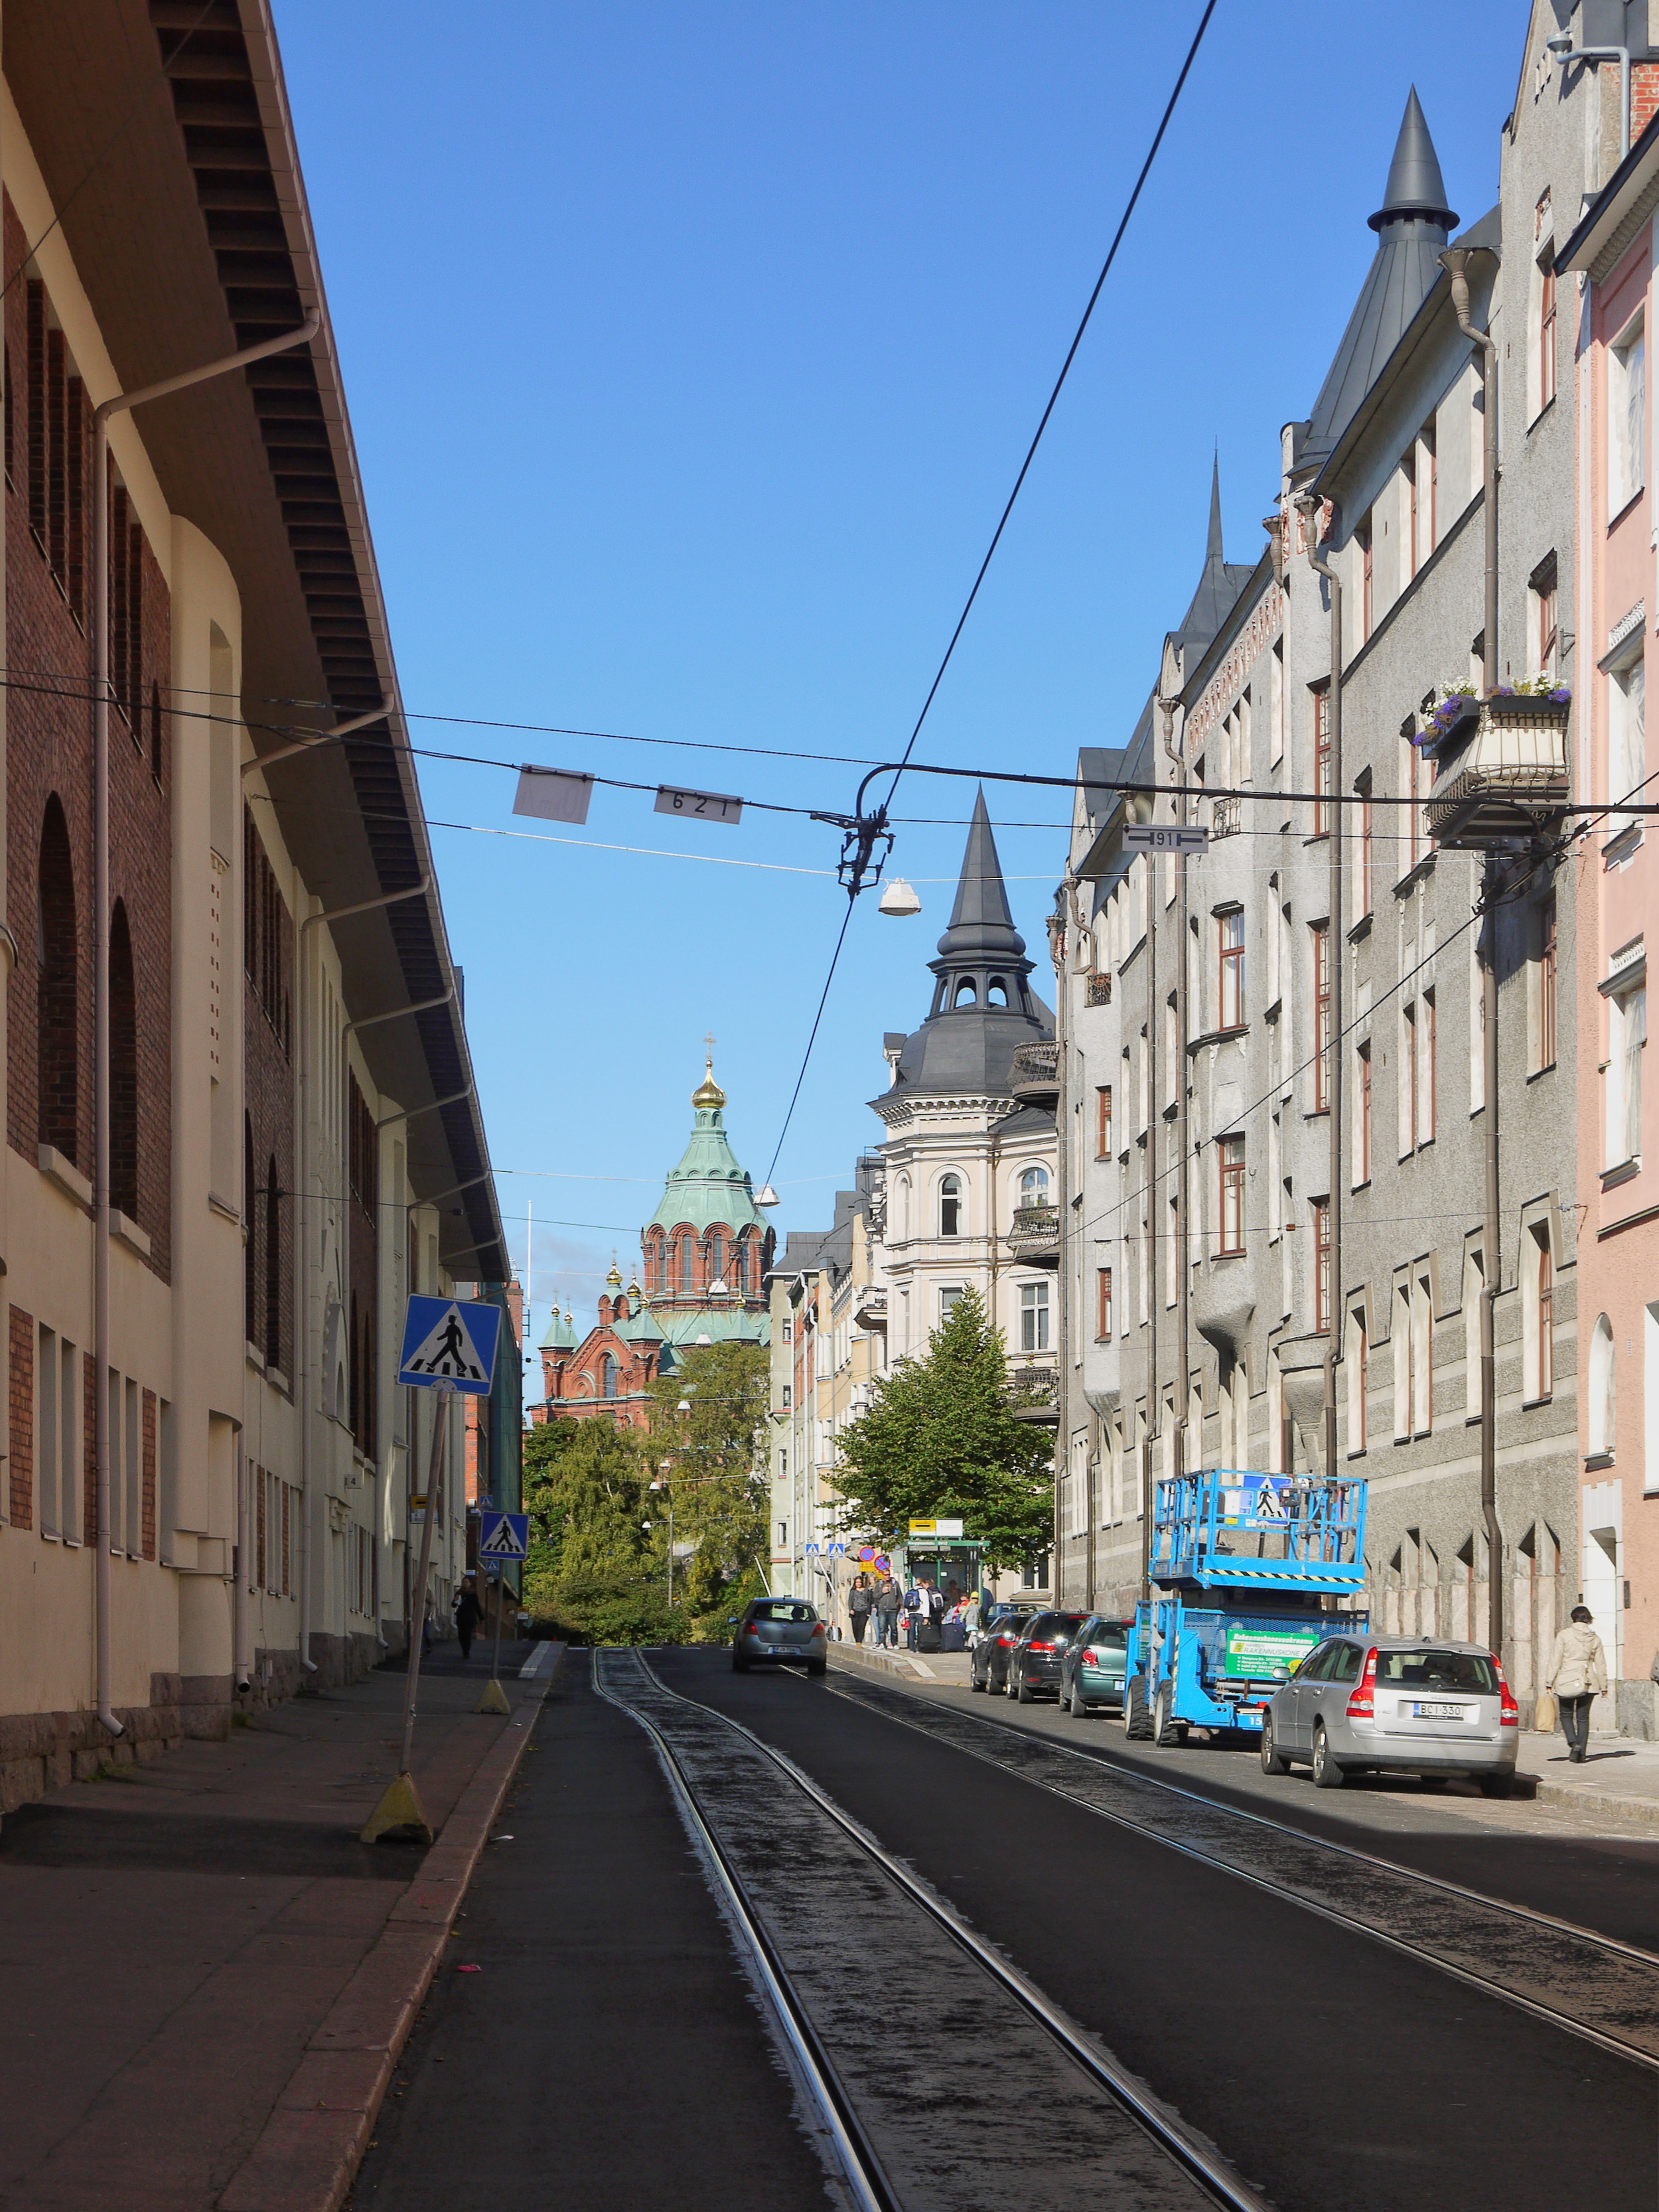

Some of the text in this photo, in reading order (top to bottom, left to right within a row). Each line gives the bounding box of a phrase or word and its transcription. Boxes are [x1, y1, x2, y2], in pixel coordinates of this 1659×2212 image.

[673, 792, 727, 816] 621
[1157, 832, 1172, 846] 91
[1243, 1647, 1300, 1657] RAKENNUSKONE
[1421, 1705, 1461, 1715] BCI-330
